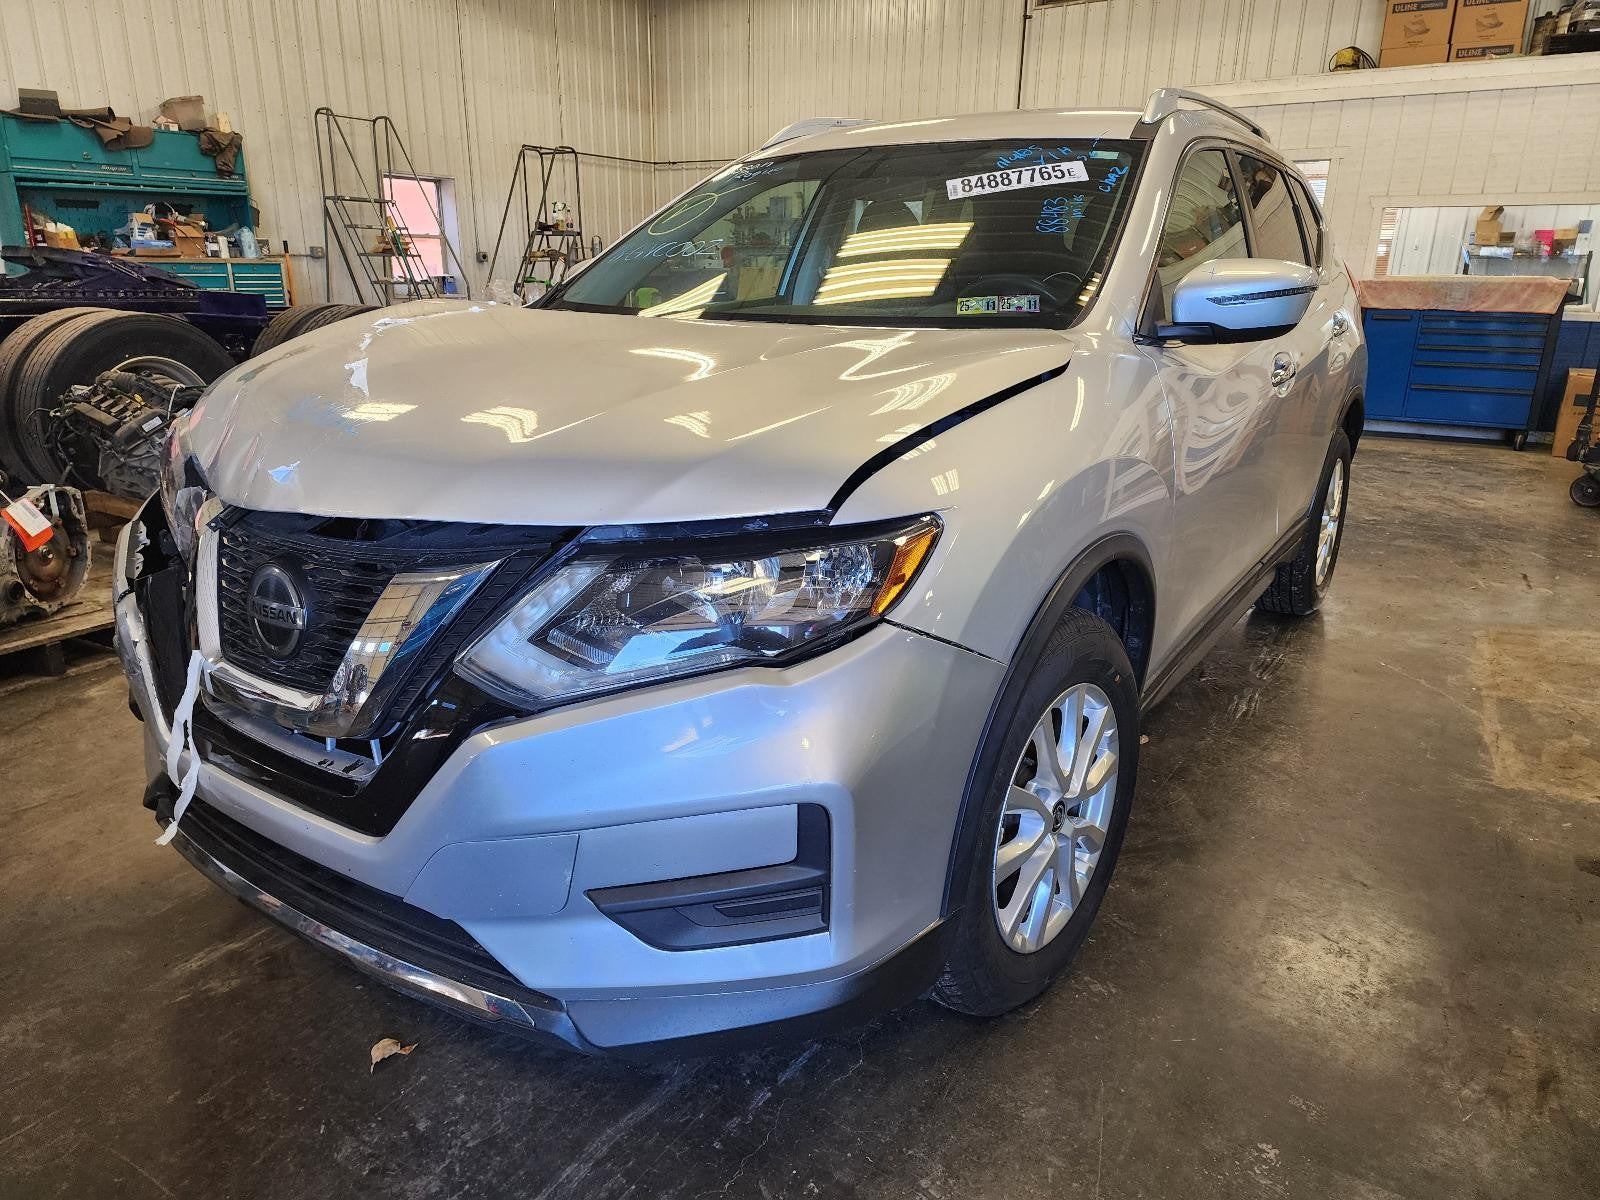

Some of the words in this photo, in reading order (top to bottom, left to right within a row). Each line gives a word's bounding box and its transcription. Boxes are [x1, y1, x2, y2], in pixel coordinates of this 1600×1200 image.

[960, 300, 970, 311] 25
[986, 301, 996, 311] 11
[1001, 298, 1011, 309] 25
[1027, 300, 1037, 309] 11
[252, 599, 298, 626] NISSAN
